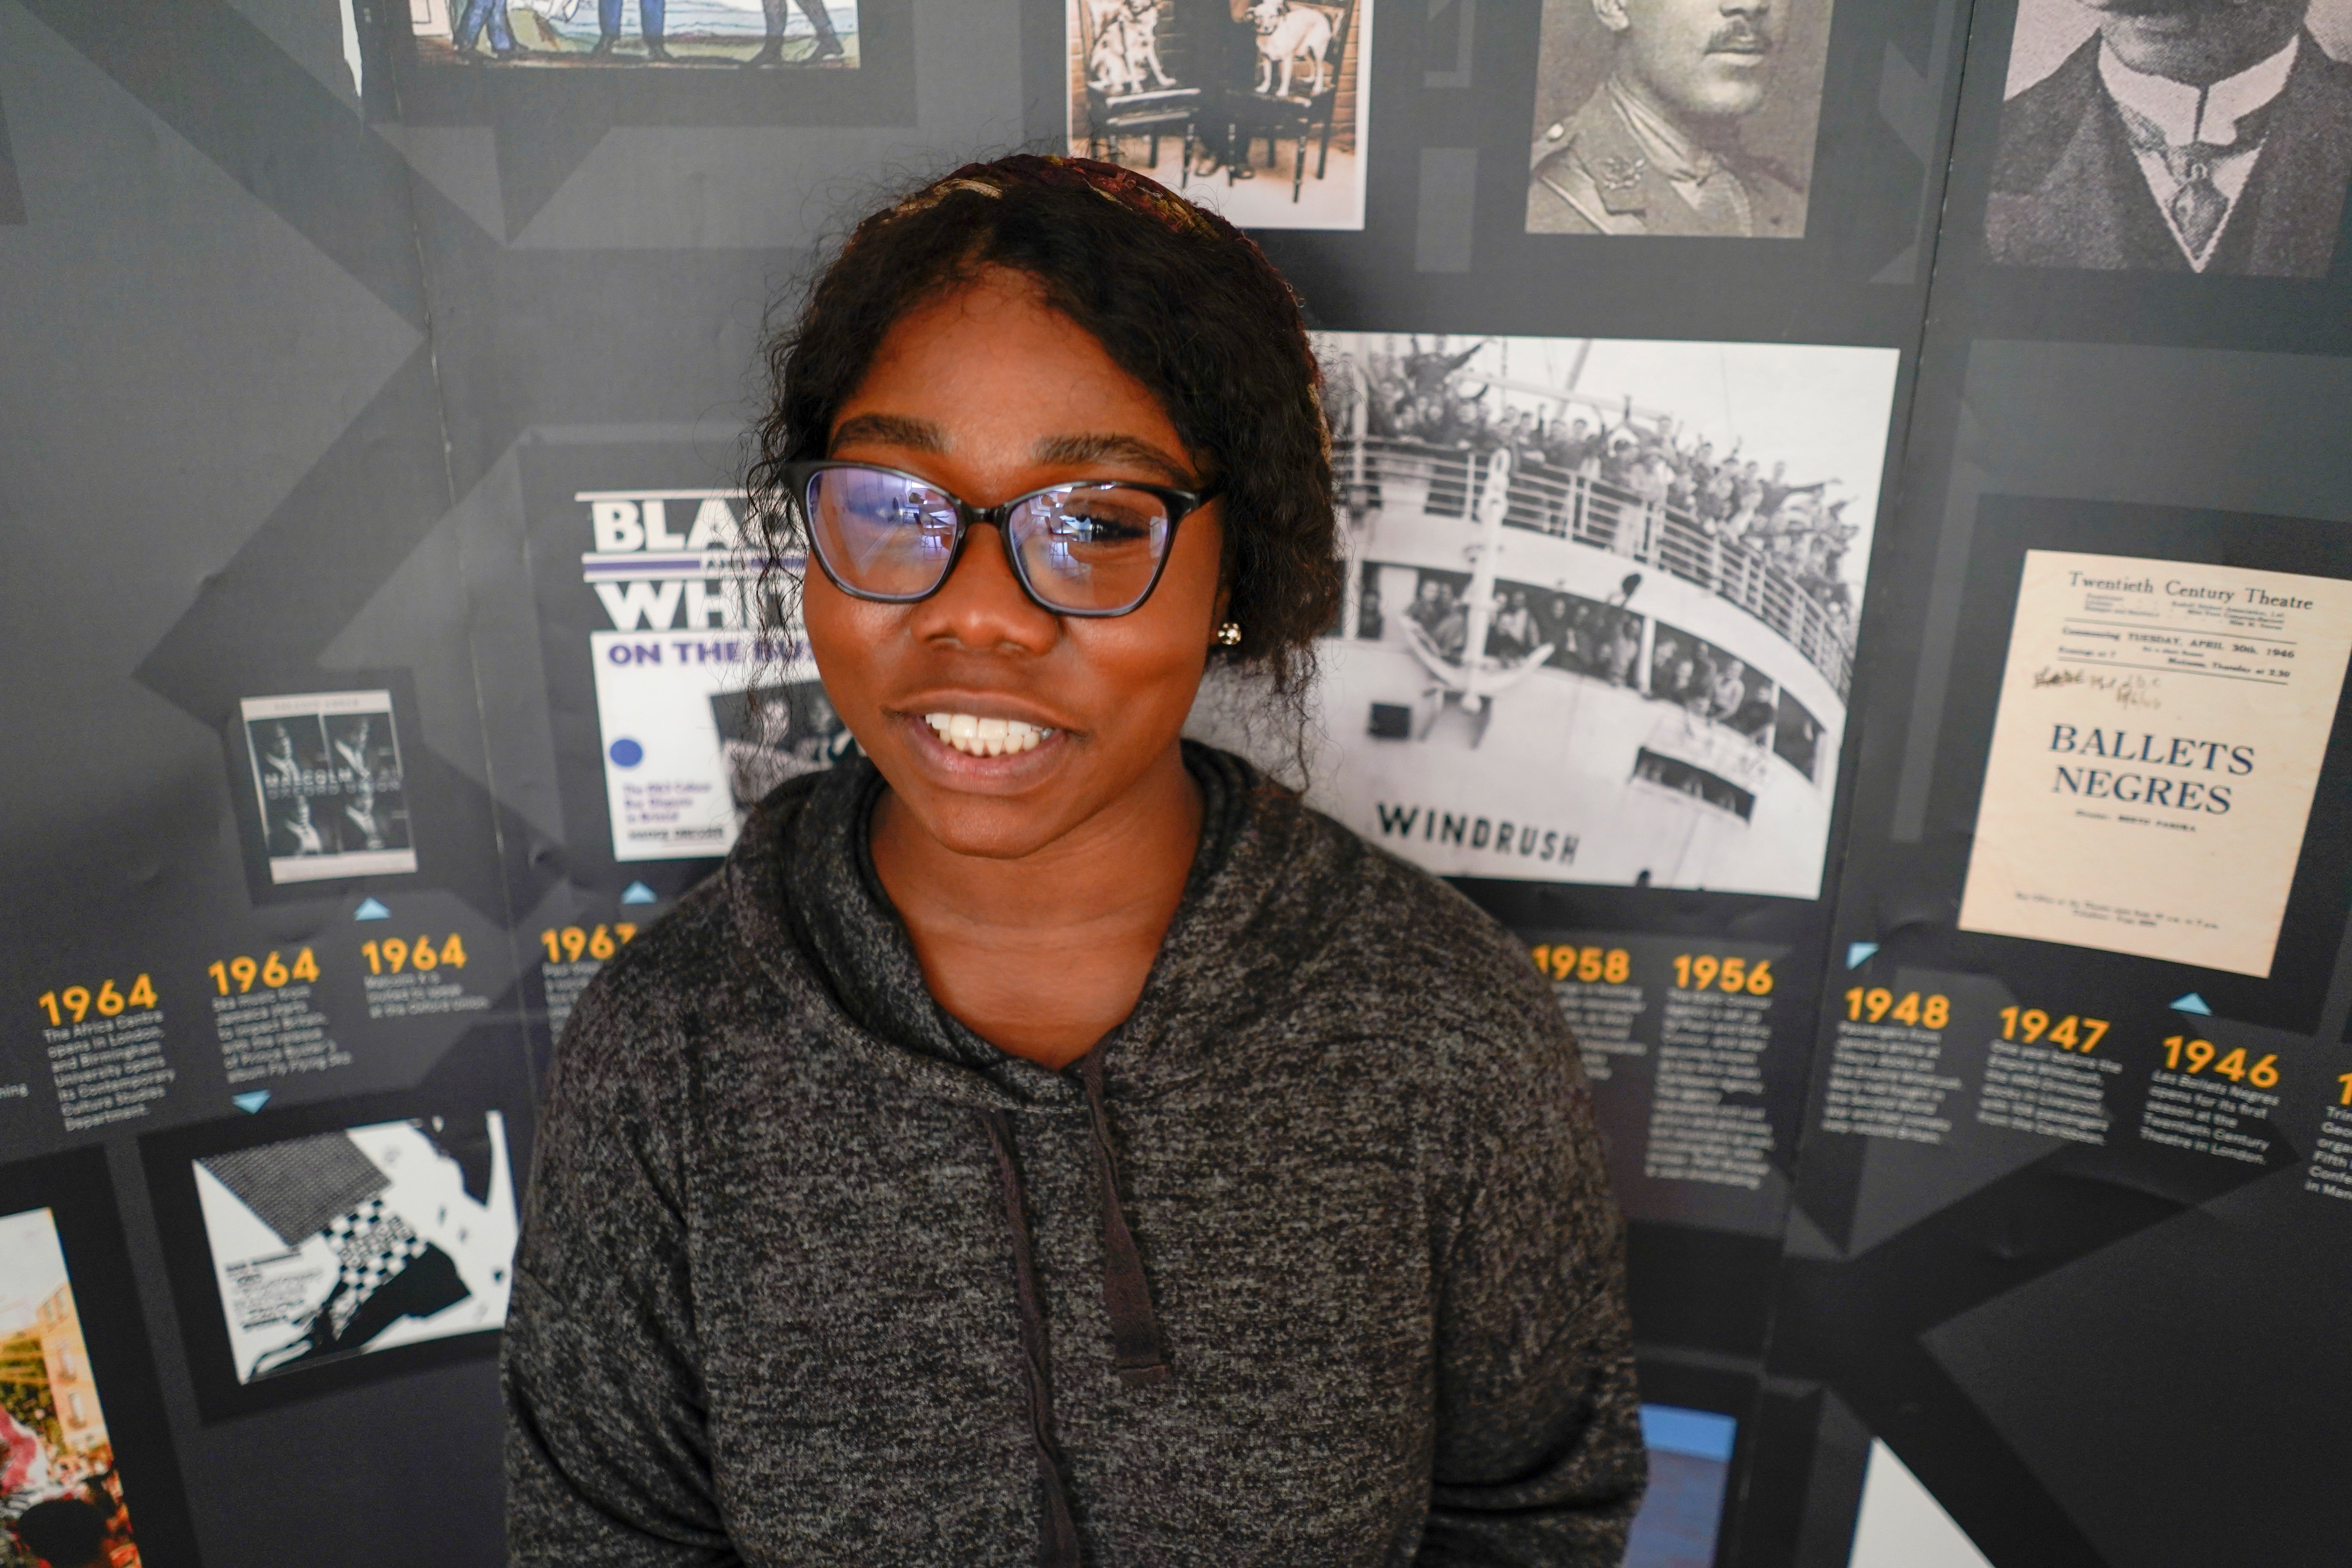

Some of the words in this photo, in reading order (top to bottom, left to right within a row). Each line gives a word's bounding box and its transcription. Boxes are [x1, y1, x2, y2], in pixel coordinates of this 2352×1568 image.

[2069, 571, 2154, 593] Twentieth
[2166, 580, 2235, 604] Century
[2245, 587, 2313, 610] Theatre
[609, 643, 660, 664] ON
[672, 641, 743, 663] THE
[2266, 648, 2295, 659] 1946
[2048, 723, 2255, 776] BALLETS
[2051, 764, 2232, 815] NEGRES
[1378, 803, 1579, 865] WINDRUSH
[208, 946, 321, 996] 1964
[361, 933, 468, 975] 1964
[1532, 944, 1630, 984] 1958
[1673, 953, 1774, 995] 1956
[39, 973, 158, 1026] 1964
[1845, 985, 1950, 1030] 1948
[43, 1027, 71, 1043] The
[116, 1010, 165, 1030] Centre
[1999, 1005, 2111, 1053] 1947
[2151, 1069, 2177, 1085] Les
[2178, 1073, 2228, 1096] Ballets
[2162, 1035, 2279, 1088] 1946
[2194, 1093, 2217, 1108] for
[2238, 1102, 2269, 1120] first
[2212, 1112, 2239, 1129] the
[2212, 1127, 2270, 1152] Century
